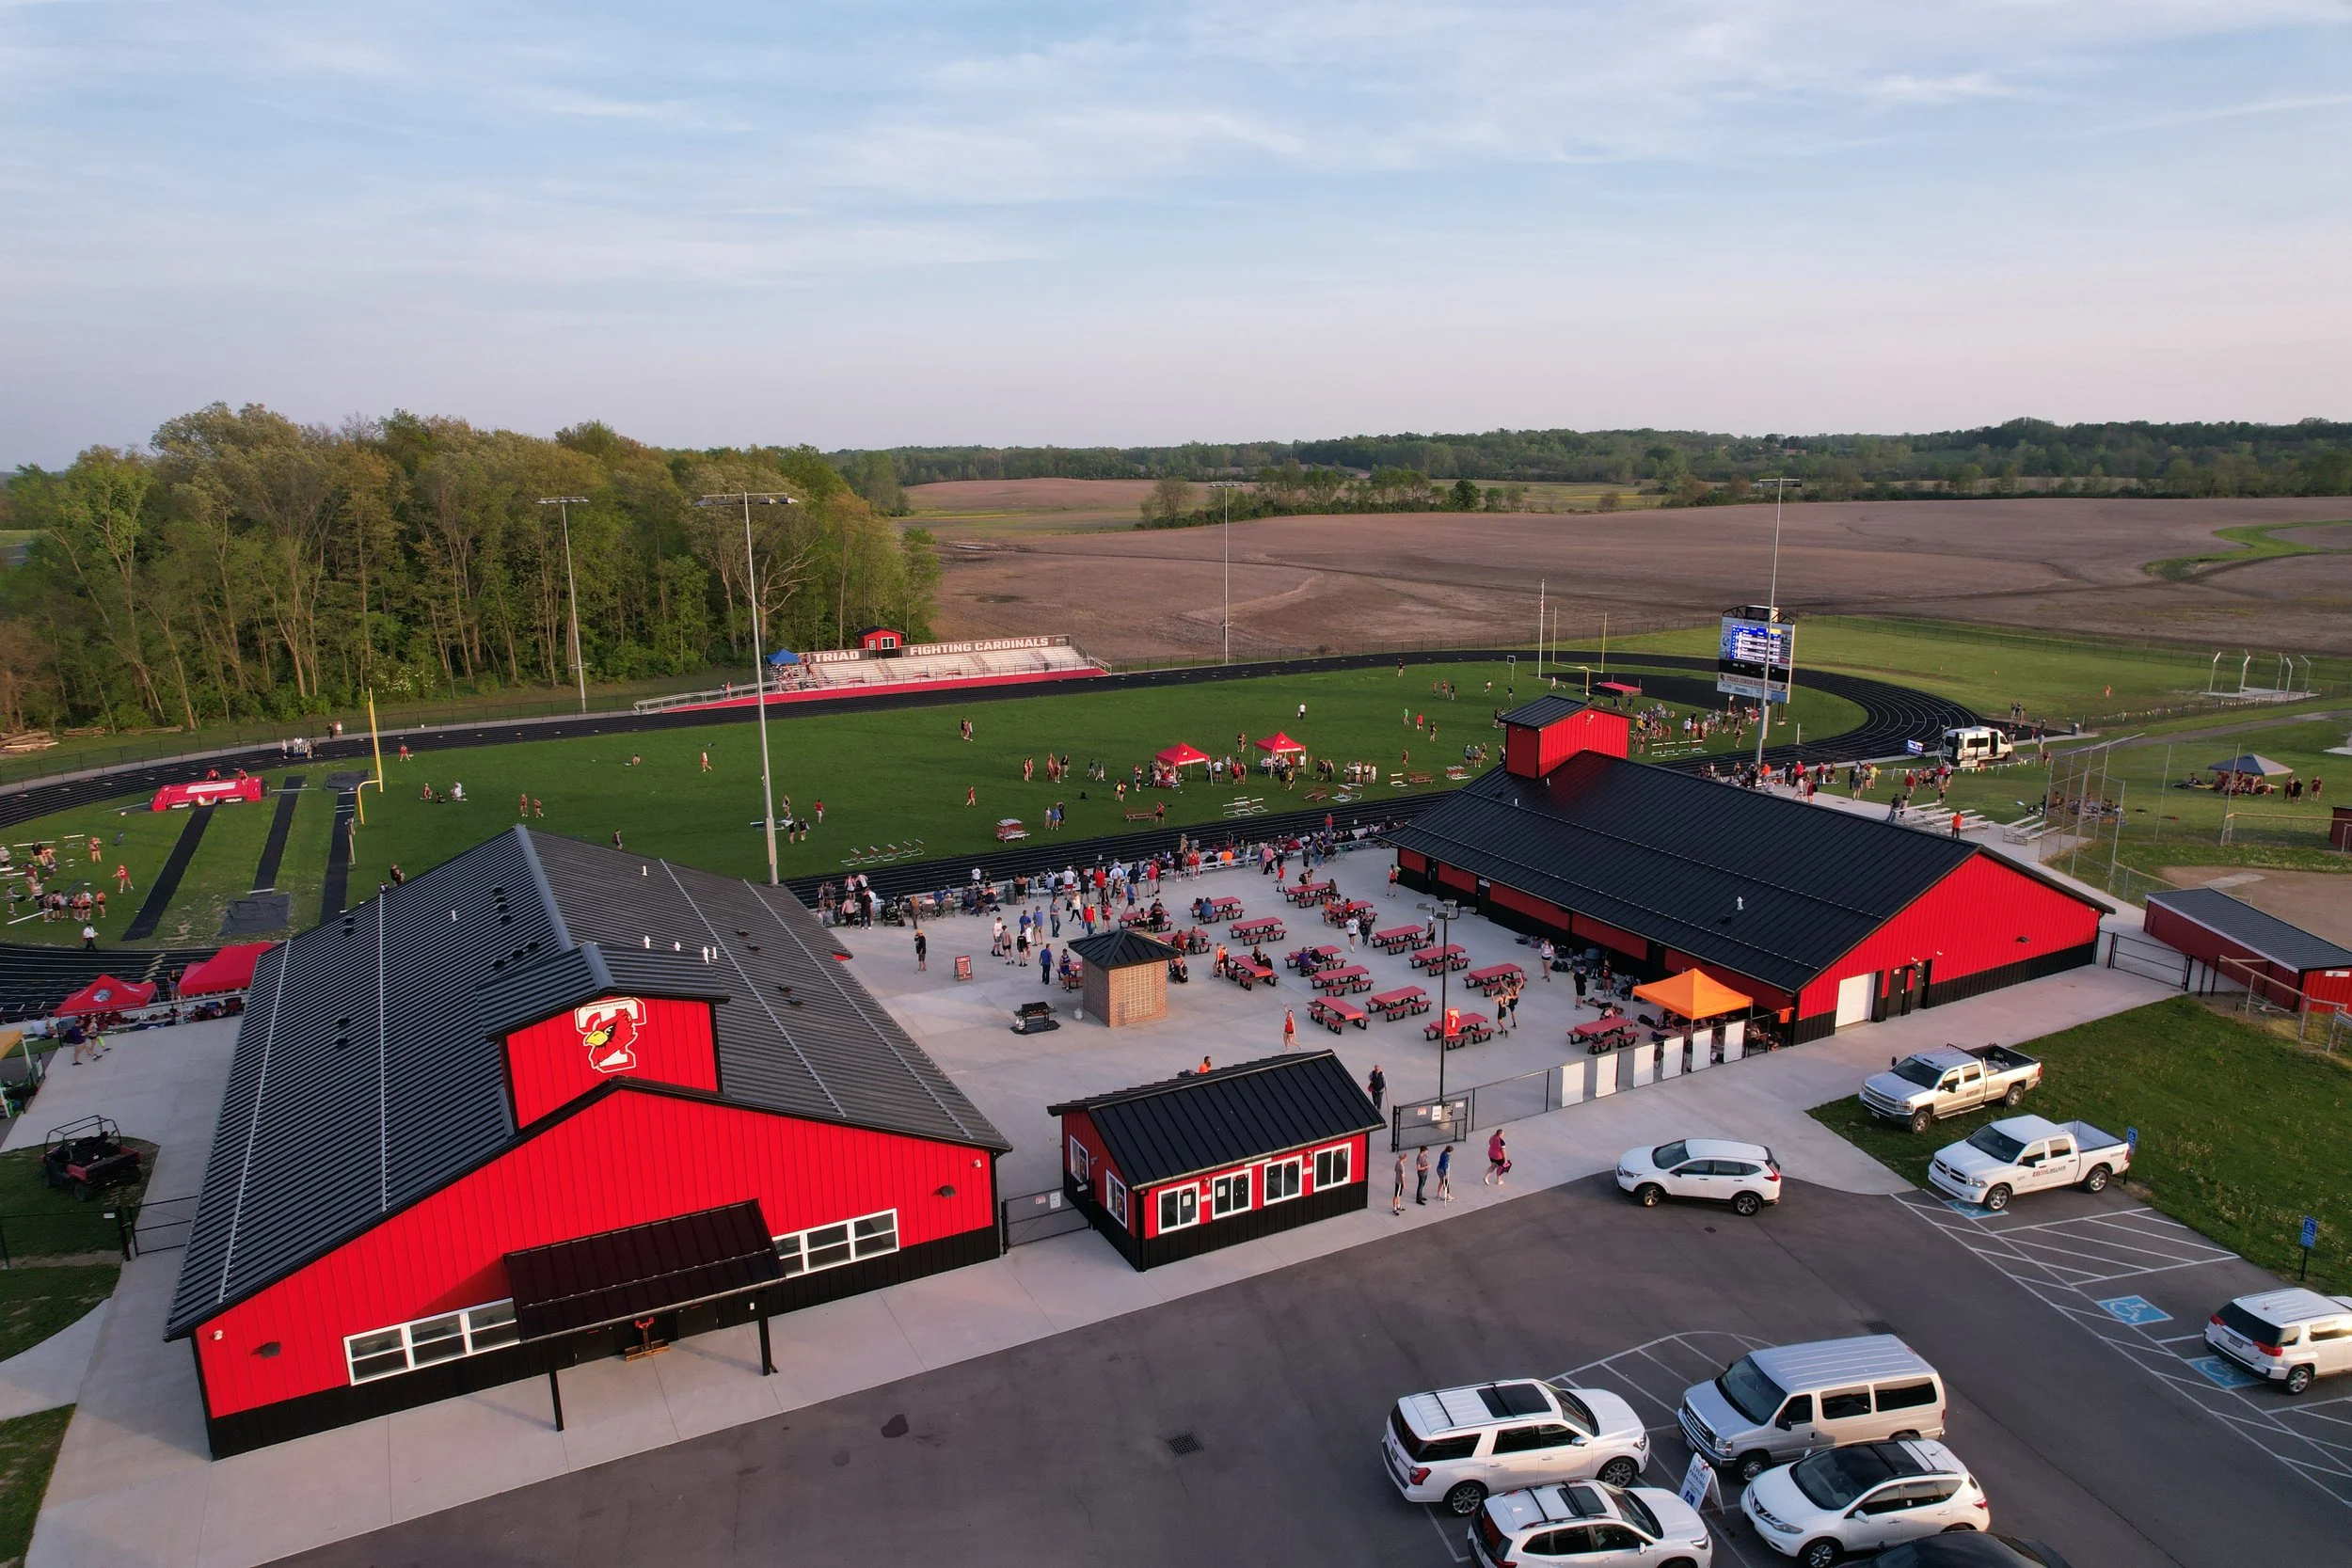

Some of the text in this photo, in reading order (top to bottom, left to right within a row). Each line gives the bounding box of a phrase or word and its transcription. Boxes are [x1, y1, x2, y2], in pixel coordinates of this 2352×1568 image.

[813, 651, 860, 662] TRIAD
[910, 642, 972, 656] FIGHTING
[975, 638, 1049, 651] CARDINALS
